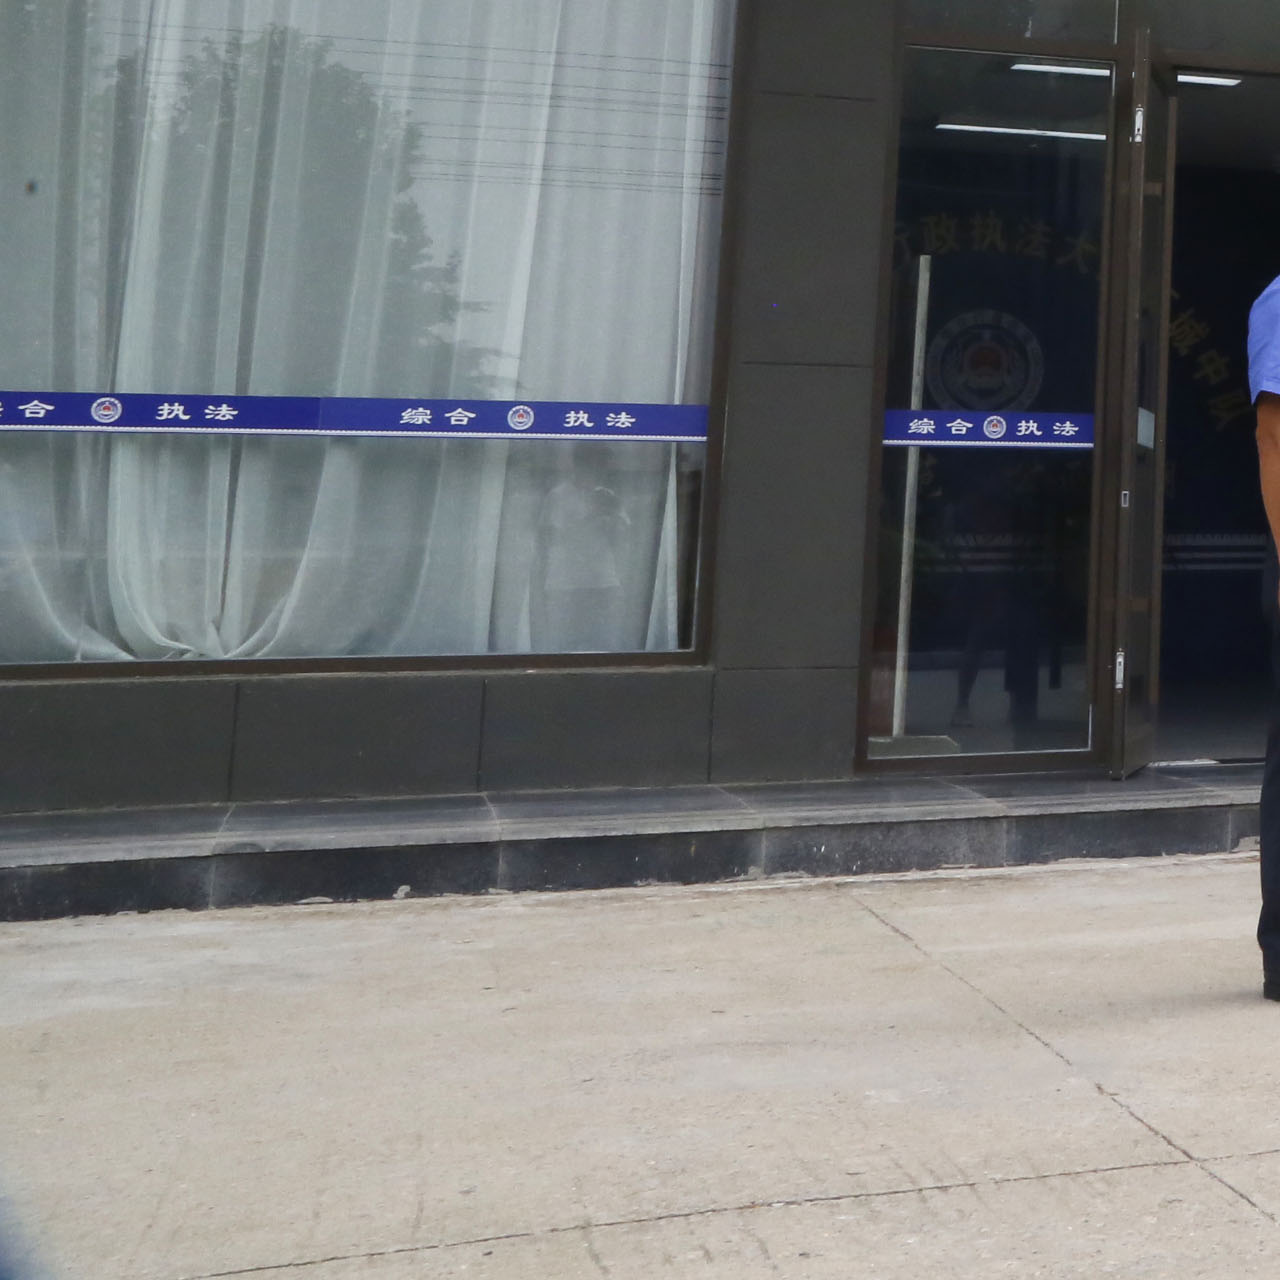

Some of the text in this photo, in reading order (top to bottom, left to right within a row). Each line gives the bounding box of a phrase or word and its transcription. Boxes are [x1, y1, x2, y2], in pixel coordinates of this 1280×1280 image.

[0, 399, 239, 422] 合 执法
[400, 407, 636, 429] 综合 执法
[908, 418, 1079, 437] 综合 执法
